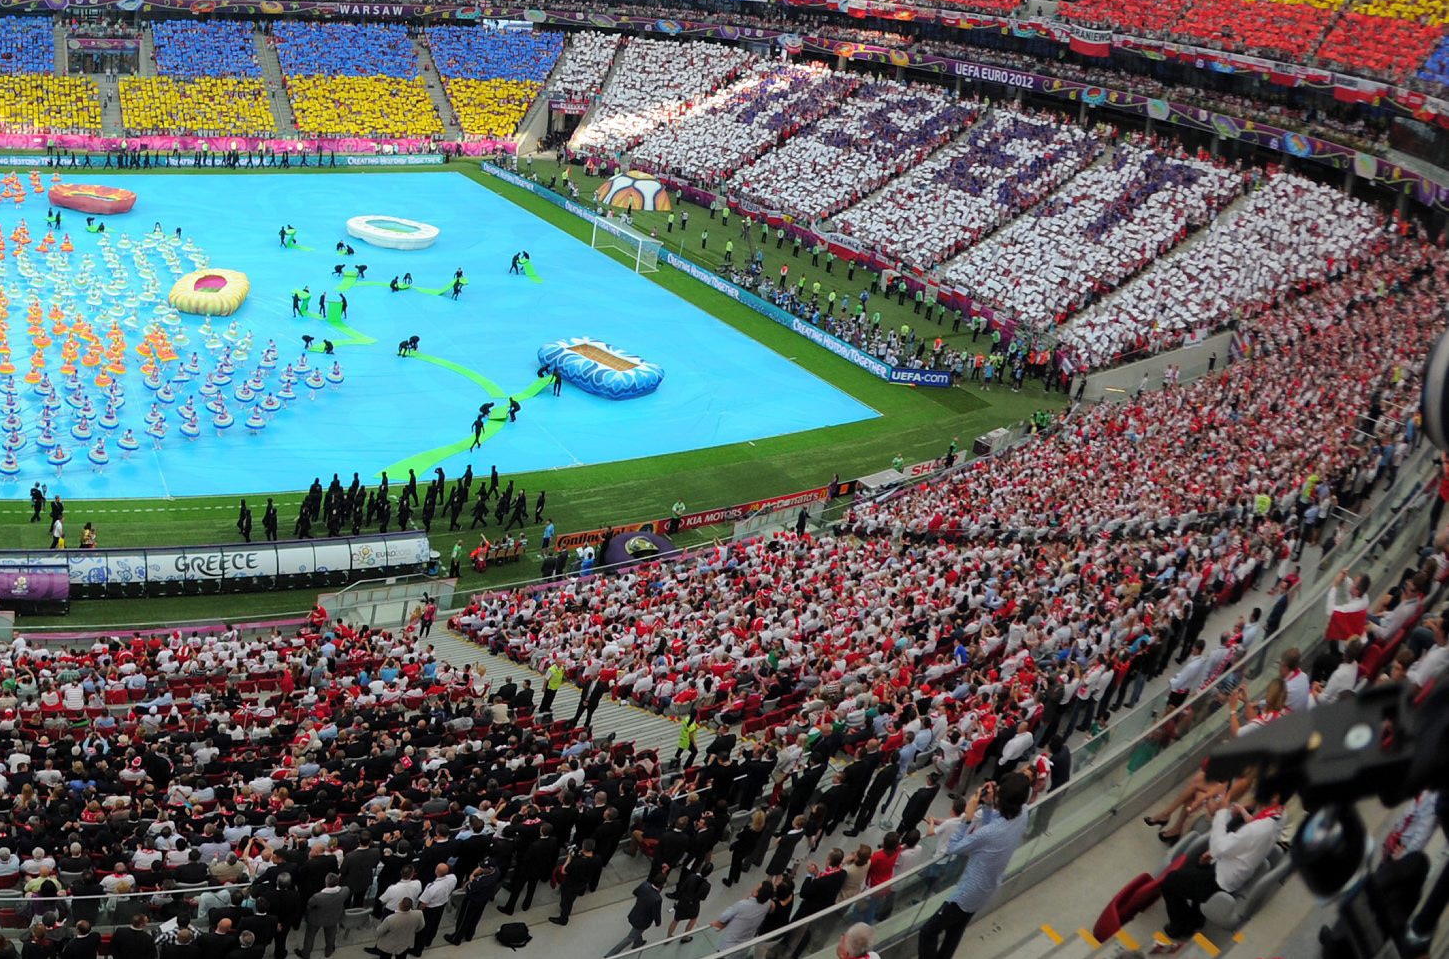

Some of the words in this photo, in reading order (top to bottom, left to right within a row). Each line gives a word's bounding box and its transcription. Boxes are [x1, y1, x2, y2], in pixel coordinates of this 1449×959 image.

[340, 4, 403, 16] WARSAW
[955, 62, 980, 78] UEFA
[981, 67, 1008, 83] EURO
[1008, 73, 1034, 88] 2012
[10, 156, 39, 165] HISTORY
[348, 157, 379, 165] CREATING
[380, 156, 406, 164] HISTORY
[407, 155, 442, 163] TOGETHER
[667, 253, 690, 273] CREATING
[691, 265, 711, 285] HISTORY
[710, 275, 740, 300] TOGETHER
[793, 318, 823, 345] CREATING
[823, 335, 850, 359] HISTORY
[850, 348, 889, 380] TOGETHER
[761, 489, 819, 510] McDonald's
[686, 515, 702, 526] KIA
[704, 507, 743, 523] MOTORS
[174, 553, 259, 577] GREECE
